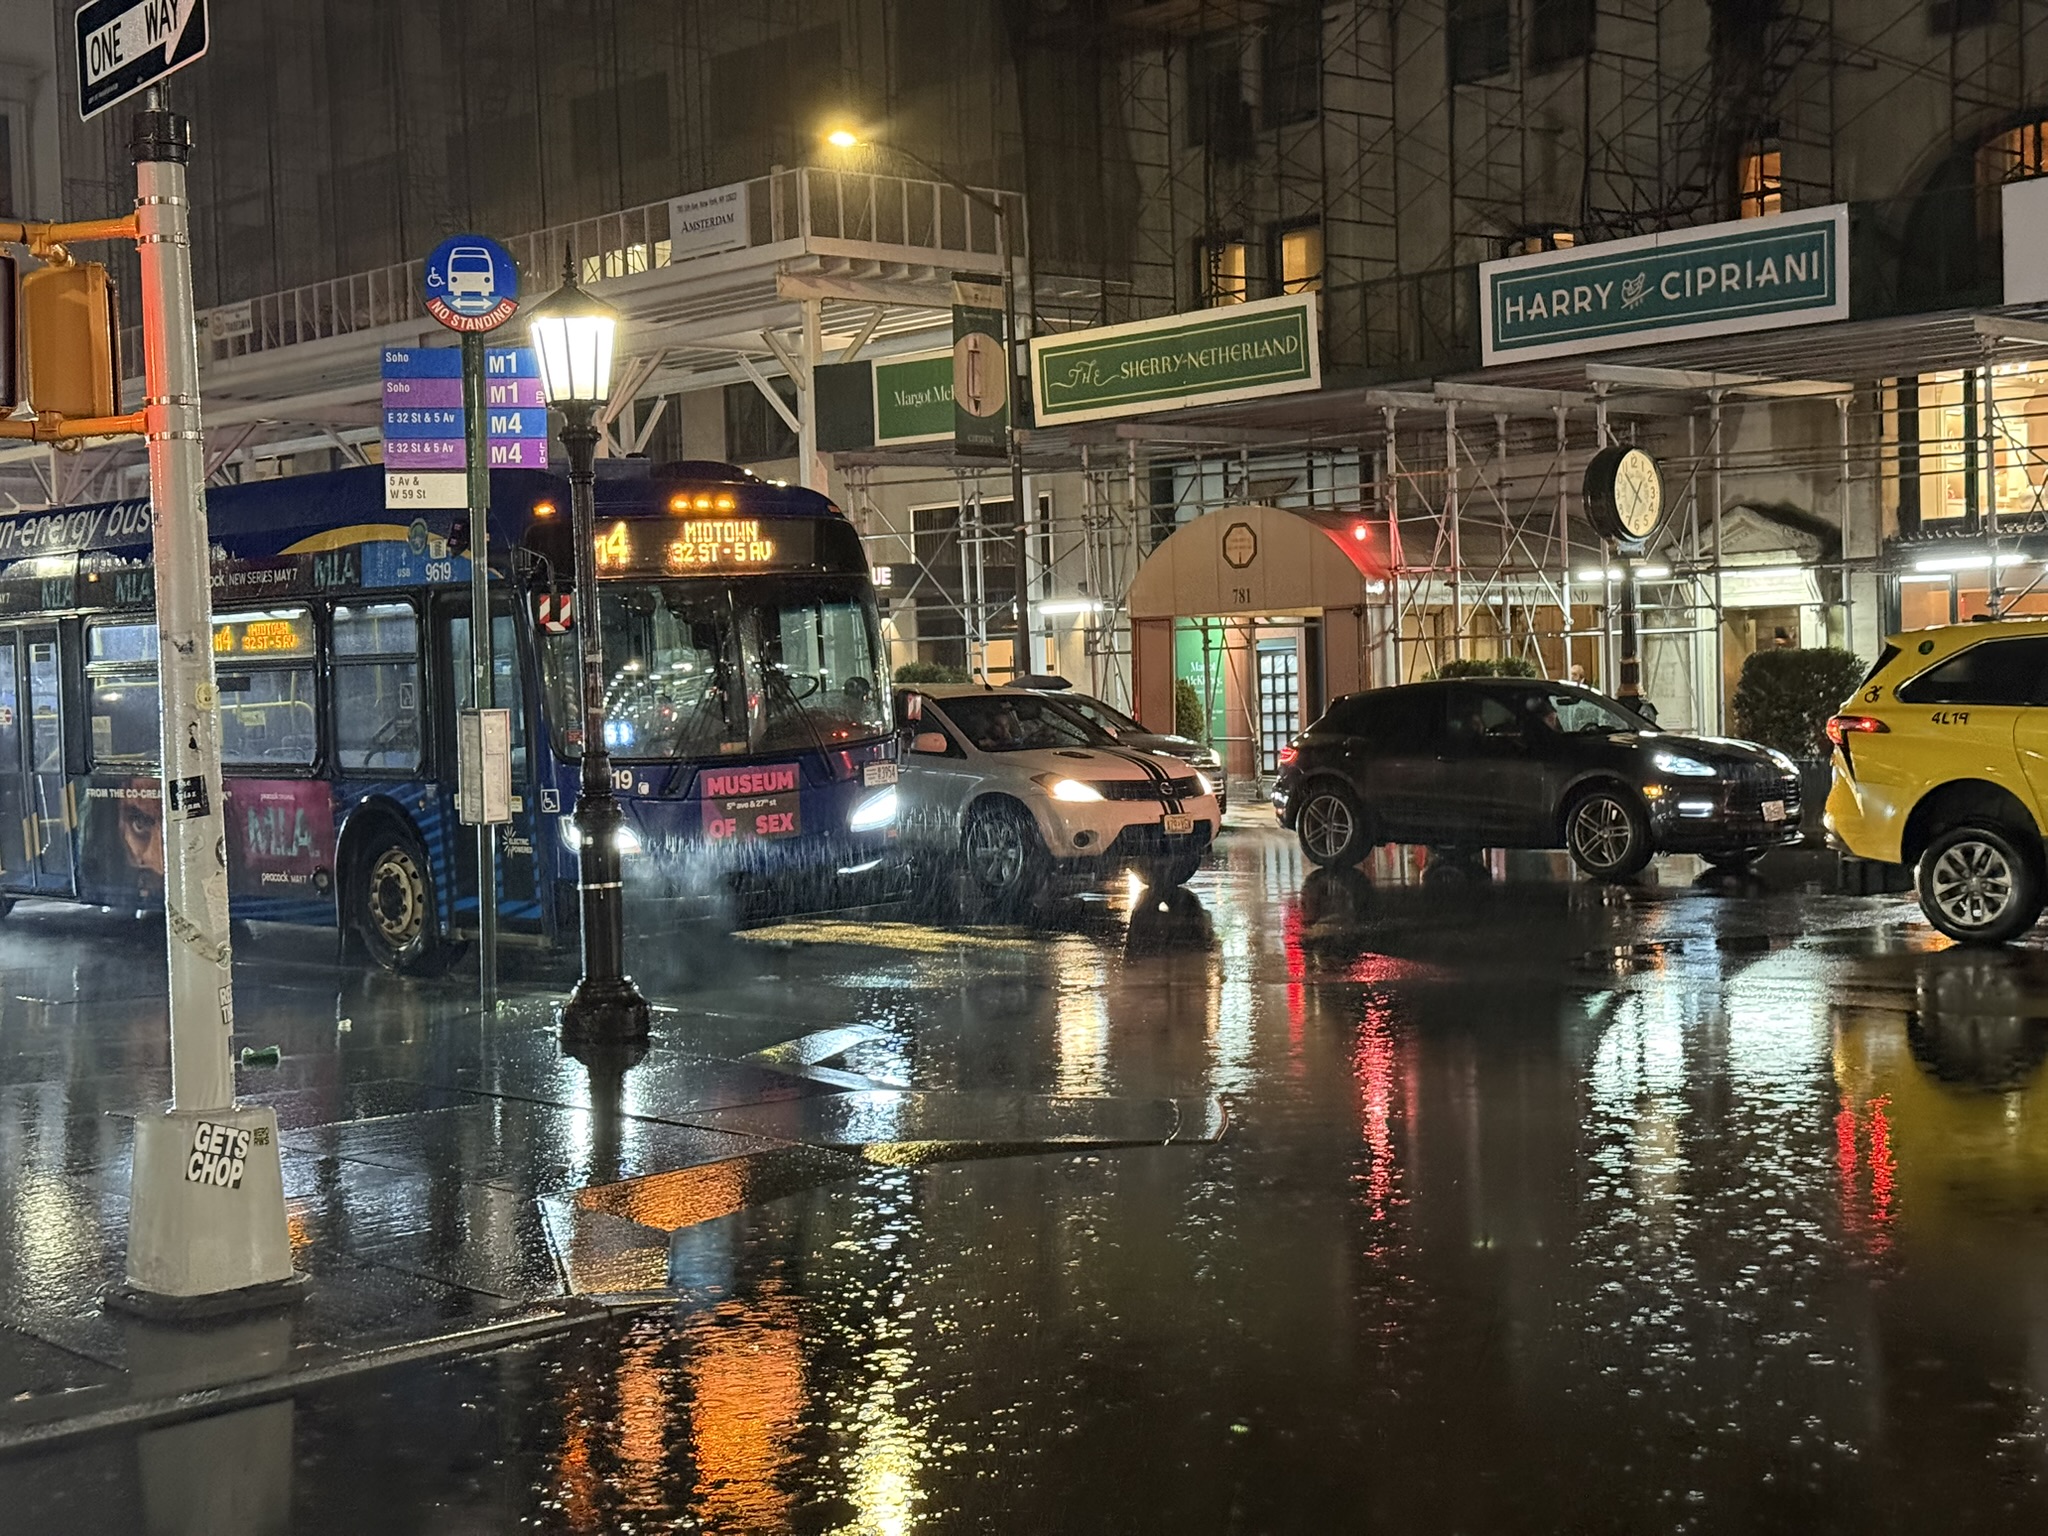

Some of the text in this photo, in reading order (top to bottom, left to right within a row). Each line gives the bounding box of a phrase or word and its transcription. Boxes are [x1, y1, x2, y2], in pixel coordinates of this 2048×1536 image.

[91, 0, 178, 77] ONE WAY
[681, 213, 735, 234] AMSTERDAM
[1505, 249, 1819, 325] HARRY CIPRIANI
[431, 300, 513, 331] NO STANDING
[385, 352, 410, 363] Soho
[489, 351, 517, 374] M1
[1120, 334, 1299, 381] SHERRY-NETHERLAND
[386, 382, 411, 393] Soho
[490, 381, 519, 404] M1
[894, 391, 932, 408] Margot
[388, 412, 455, 423] E 32 St & 5 Av
[491, 412, 523, 434] M4
[388, 442, 454, 453] E 32 St & 5 Av
[491, 442, 523, 464] M4
[389, 476, 420, 486] 5 Av &
[390, 489, 426, 499] W 59 St
[105, 500, 151, 538] bus
[684, 520, 759, 543] MIDTOWN
[672, 542, 695, 562] 32
[697, 542, 719, 562] ST
[734, 542, 746, 562] 5
[749, 540, 773, 561] AV
[228, 572, 246, 586] NEW
[246, 569, 273, 585] SERIES
[273, 568, 291, 583] MAY
[292, 567, 298, 580] 7
[425, 562, 451, 582] 9619
[1232, 588, 1250, 604] 781
[248, 621, 290, 637] MIDTOWN
[243, 636, 257, 650] 32
[257, 636, 269, 649] ST
[275, 635, 282, 649] 5
[283, 634, 297, 648] AV
[86, 788, 109, 798] FROM
[109, 788, 125, 799] THE
[707, 771, 795, 797] MUSEUM
[736, 801, 749, 810] ave
[749, 800, 756, 809] &
[769, 798, 777, 807] st
[709, 812, 795, 840] OF SEX
[261, 870, 289, 886] peacock
[194, 1122, 250, 1159] GETS
[187, 1150, 244, 1189] CHOP
